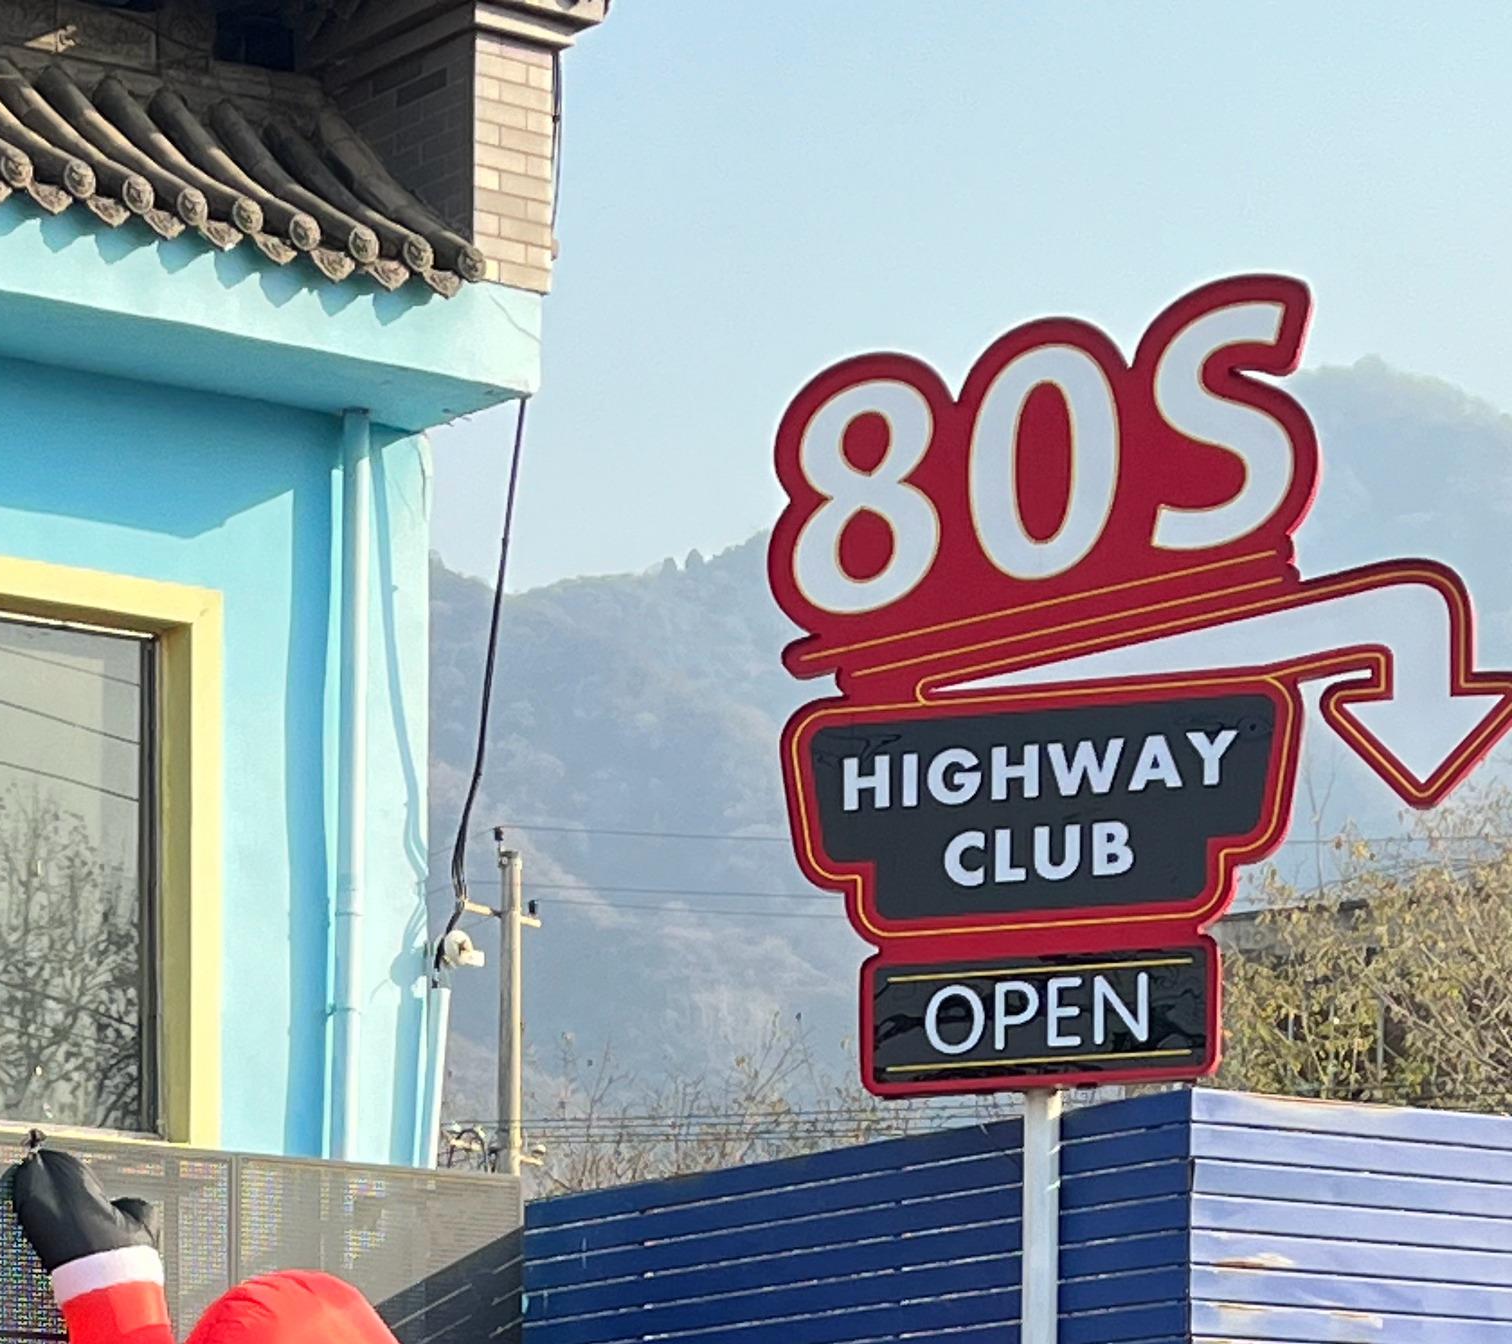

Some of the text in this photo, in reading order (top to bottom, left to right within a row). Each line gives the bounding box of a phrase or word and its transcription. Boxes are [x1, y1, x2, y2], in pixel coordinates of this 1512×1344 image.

[791, 300, 1299, 616] 80S
[841, 730, 1241, 813] HIGHWAY
[942, 820, 1136, 888] CLUB
[923, 970, 1152, 1056] OPEN
